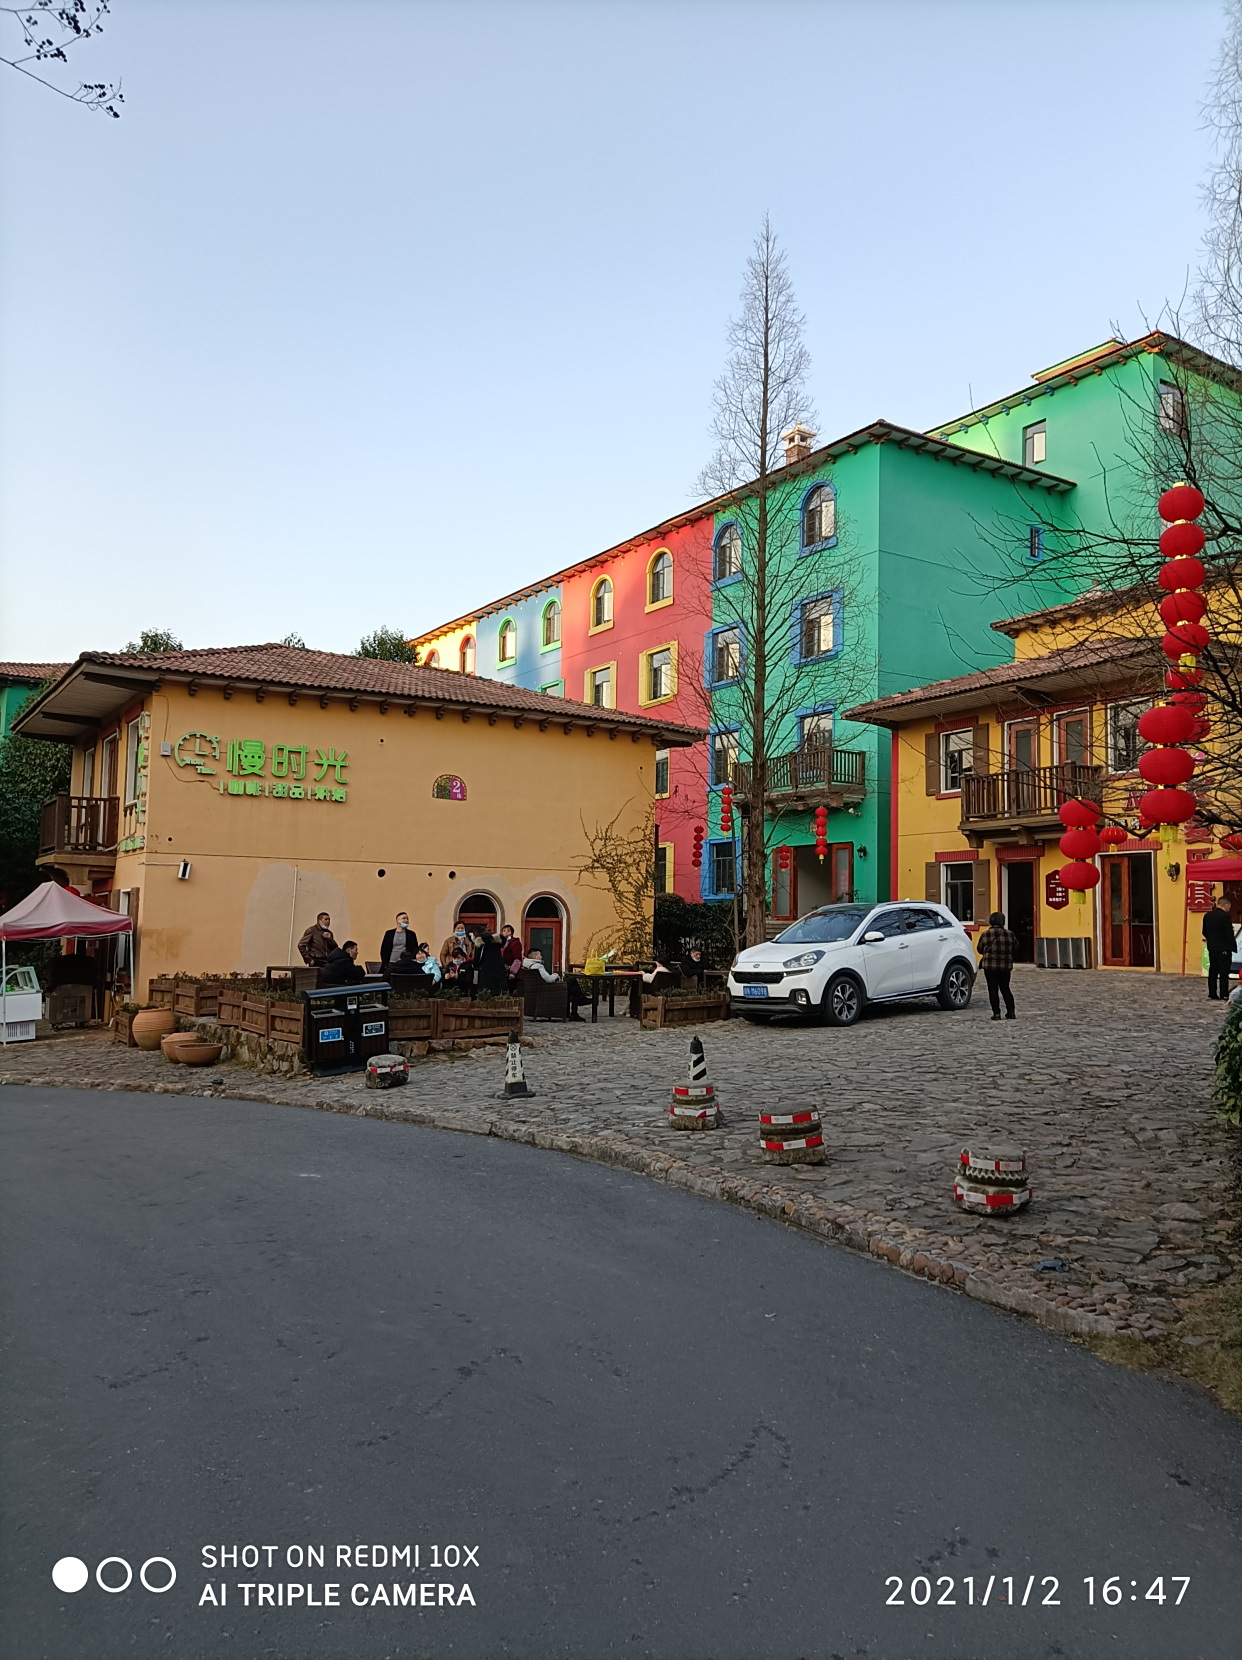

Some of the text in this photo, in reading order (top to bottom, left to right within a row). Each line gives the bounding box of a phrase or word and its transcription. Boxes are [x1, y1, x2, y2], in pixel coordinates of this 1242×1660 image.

[227, 738, 349, 784] 慢时光
[273, 782, 305, 799] 甜品
[452, 780, 461, 792] 2
